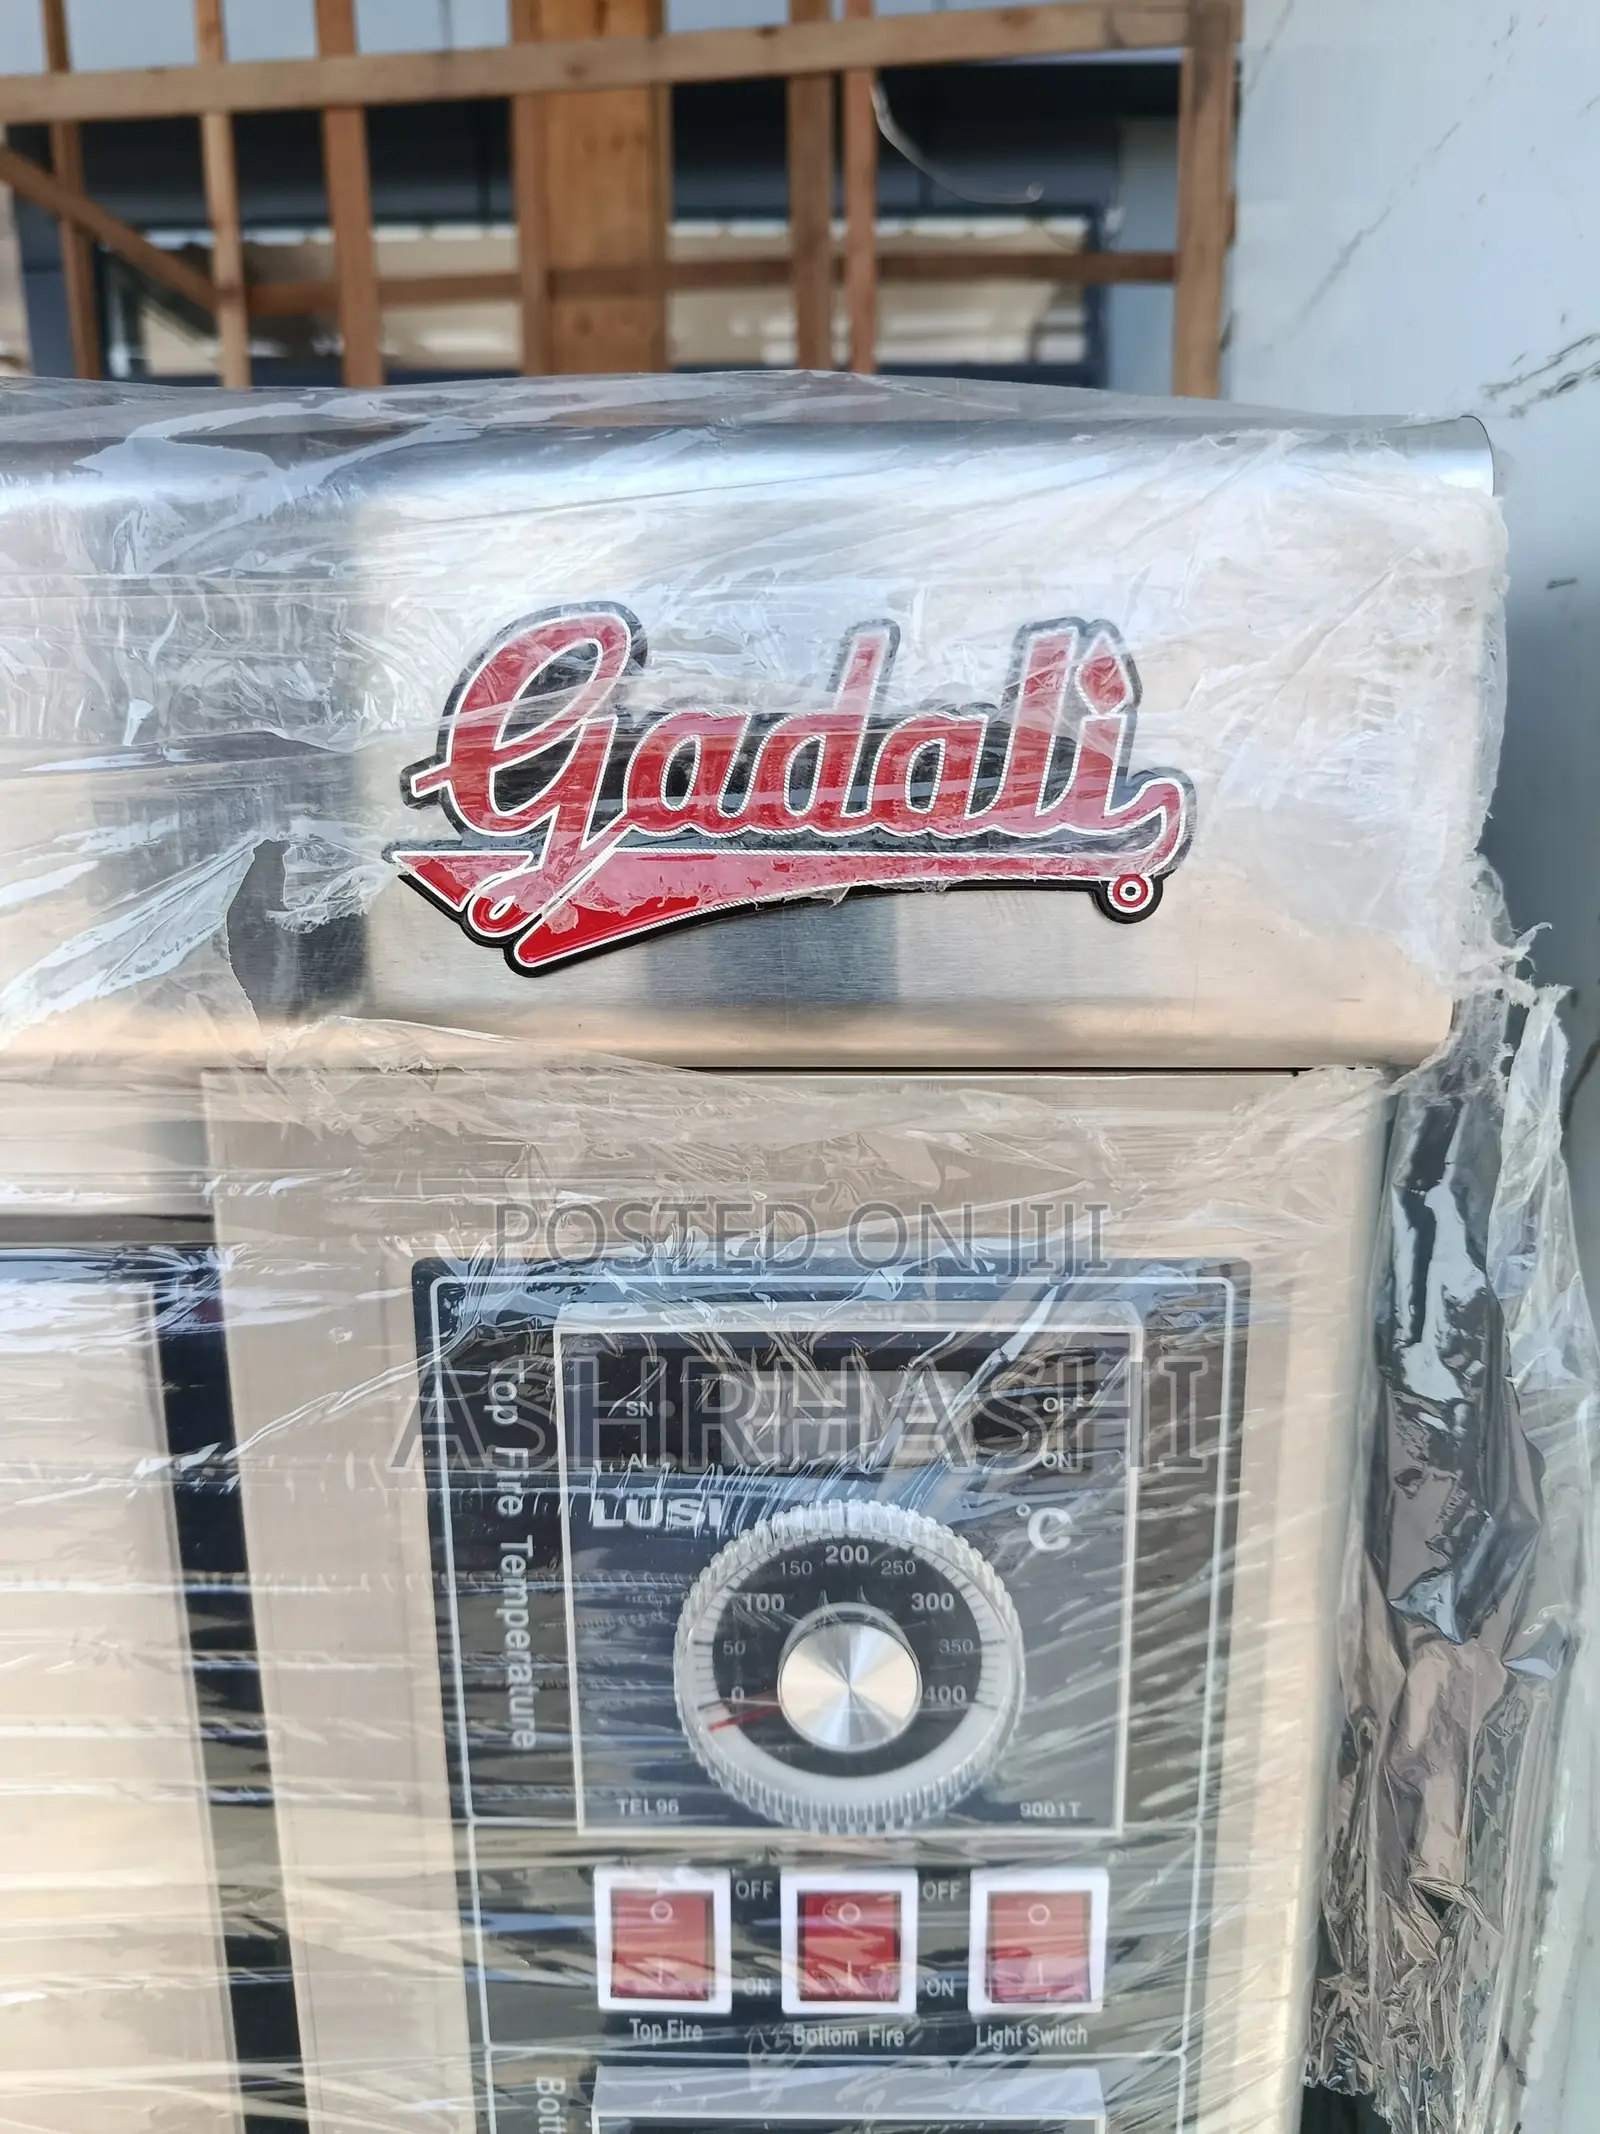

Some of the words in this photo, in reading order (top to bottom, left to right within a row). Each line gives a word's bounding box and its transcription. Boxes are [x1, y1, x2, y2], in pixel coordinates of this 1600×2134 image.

[404, 603, 1195, 942] Gadali
[484, 1359, 525, 1425] Top
[625, 1400, 654, 1417] SN
[1042, 1396, 1085, 1413] OFF
[1041, 1452, 1073, 1469] ON
[494, 1447, 529, 1516] Fire
[592, 1498, 722, 1528] LUSI
[825, 1545, 869, 1564] 200
[779, 1560, 813, 1575] 150
[880, 1560, 916, 1575] 250
[744, 1593, 785, 1612] 100
[911, 1593, 954, 1612] 300
[494, 1535, 538, 1750] Temperature
[723, 1640, 746, 1655] 50
[939, 1639, 974, 1654] 350
[731, 1686, 745, 1702] 0
[923, 1686, 966, 1702] 400
[617, 1799, 680, 1816] TEL96
[1019, 1801, 1082, 1817] 9001T
[734, 1880, 774, 1899] OFF
[922, 1880, 961, 1900] OFF
[742, 1977, 772, 1996] ON
[926, 1978, 955, 1997] ON
[628, 2017, 665, 2045] Top
[667, 2018, 704, 2042] Fire
[792, 2023, 859, 2047] Bottom
[868, 2023, 905, 2047] Fire
[975, 2024, 1022, 2051] Light
[1026, 2023, 1089, 2048] Switch
